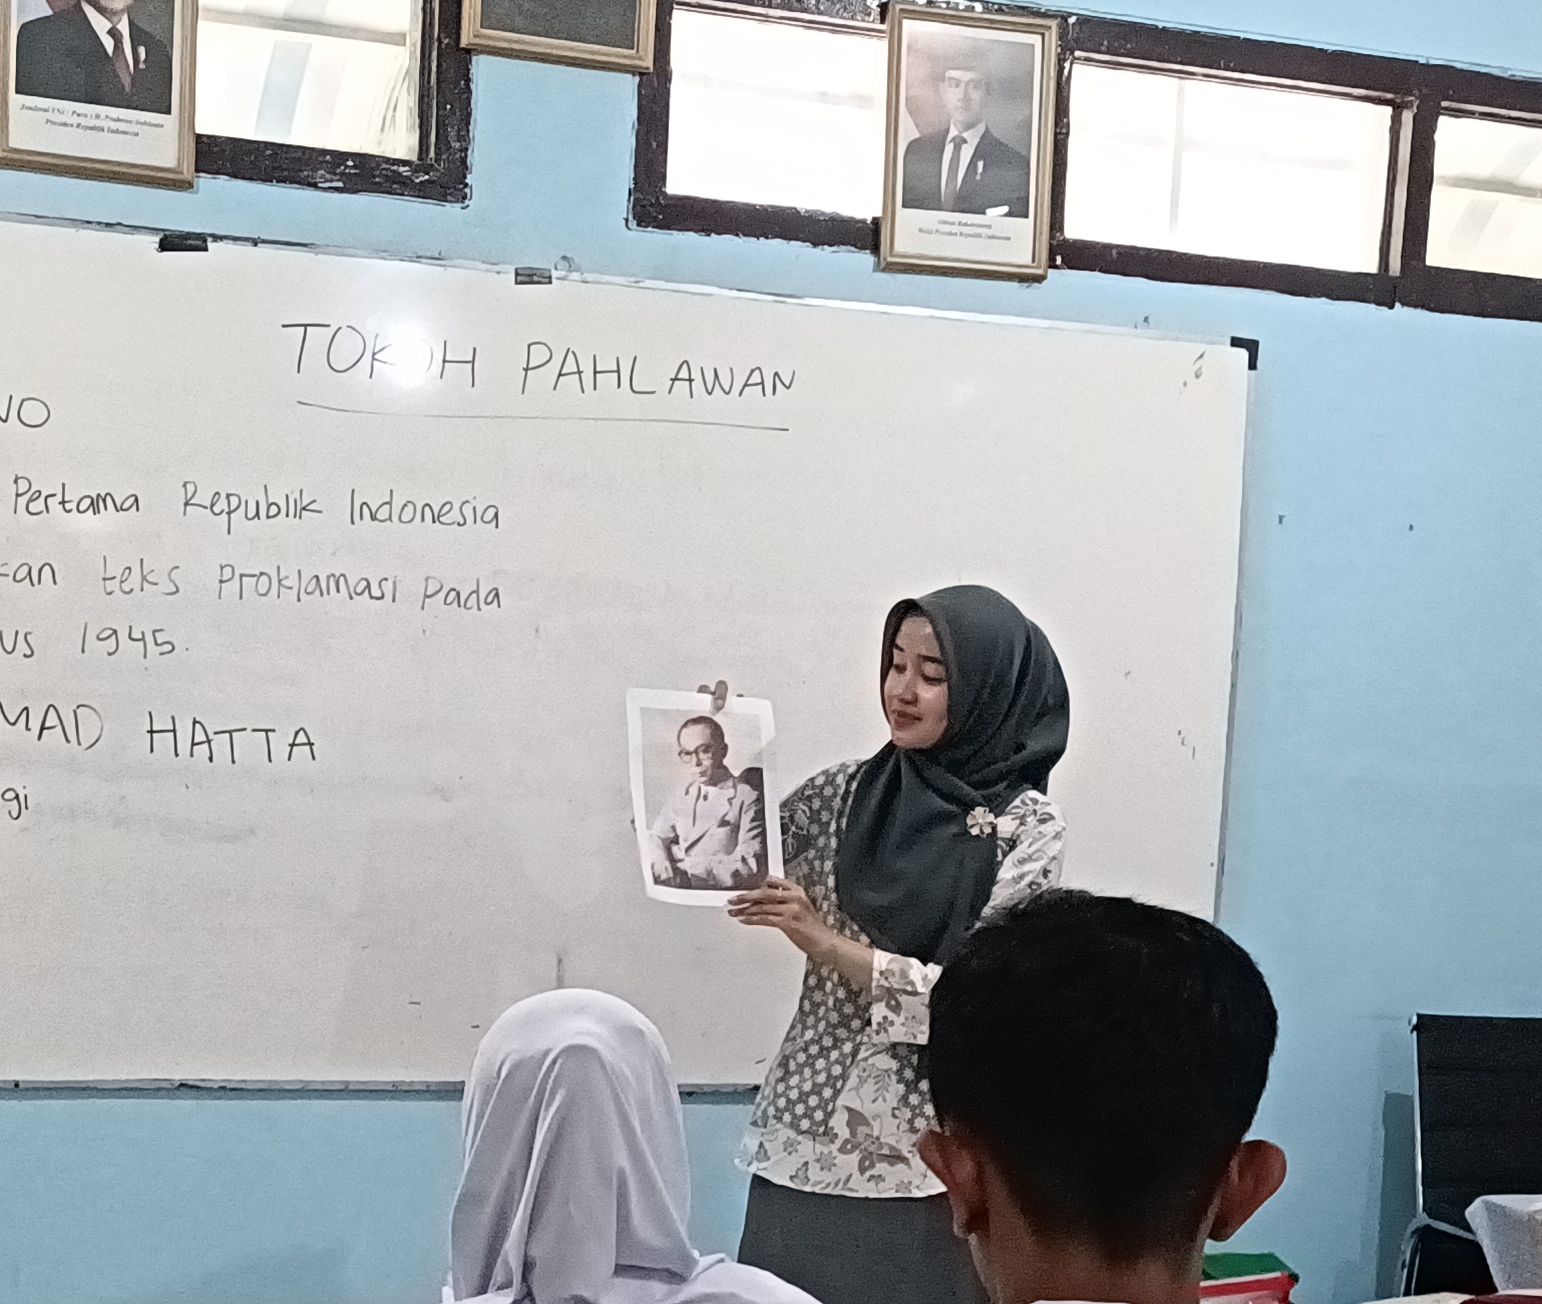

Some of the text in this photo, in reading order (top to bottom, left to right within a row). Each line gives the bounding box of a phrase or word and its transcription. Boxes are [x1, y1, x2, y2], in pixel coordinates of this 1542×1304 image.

[521, 341, 795, 399] PAHLAWAN
[13, 474, 139, 516] Pertama
[182, 481, 323, 535] Republik
[351, 489, 499, 529] Indonesia
[102, 556, 180, 595] teks
[218, 564, 397, 603] Proklamasi
[146, 711, 316, 765] HATTA
